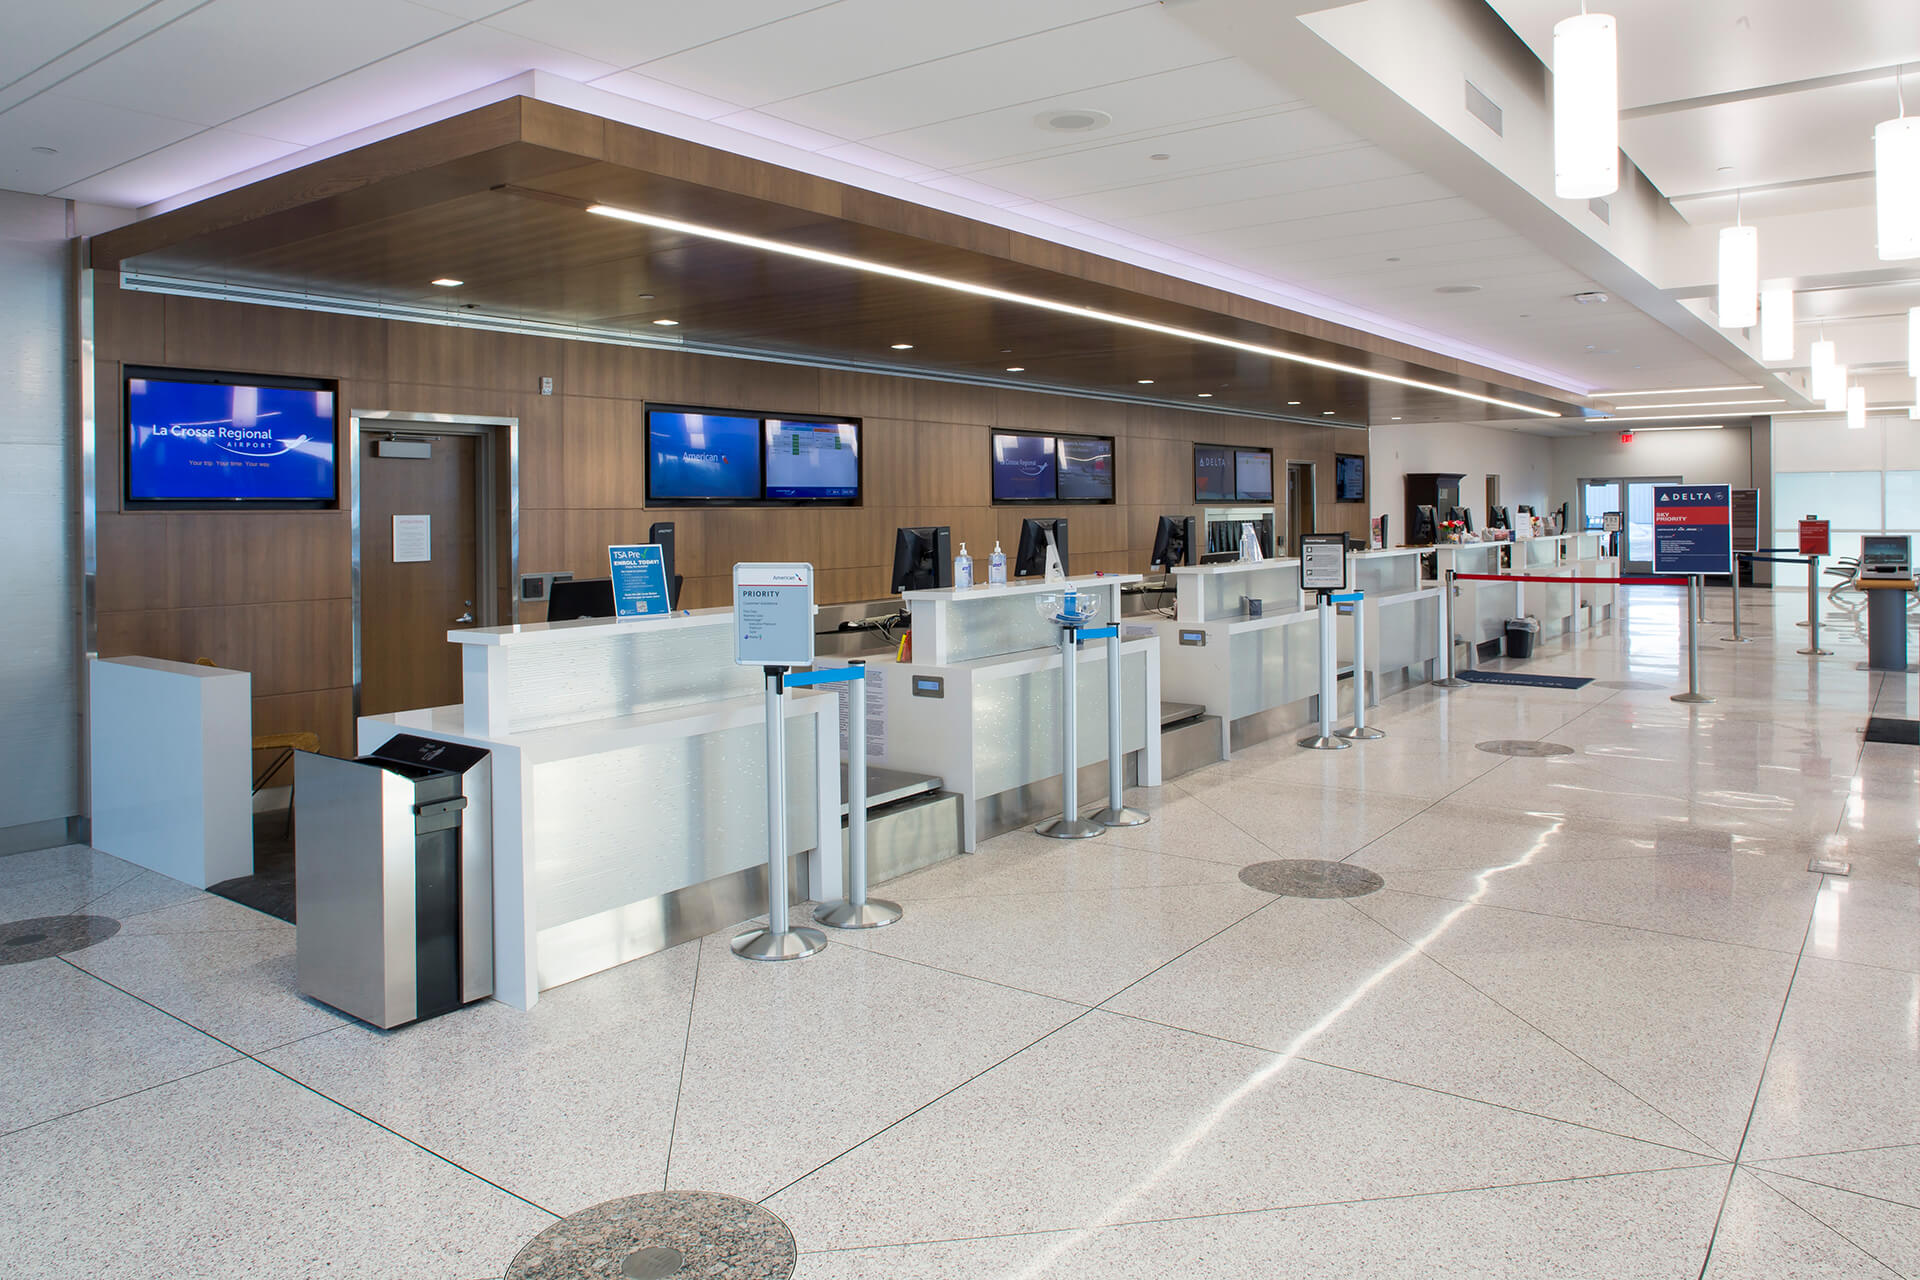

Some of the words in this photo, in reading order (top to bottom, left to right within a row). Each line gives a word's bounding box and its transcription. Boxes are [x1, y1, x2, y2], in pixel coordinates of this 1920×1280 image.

[153, 424, 168, 436] La
[171, 425, 216, 438] Crosse
[218, 427, 272, 441] Regional
[682, 451, 719, 462] American
[1205, 457, 1226, 466] DELTA
[1672, 492, 1712, 501] DELTA
[613, 551, 628, 559] TSA
[628, 550, 641, 559] Pre
[743, 590, 780, 598] PRIORITY
